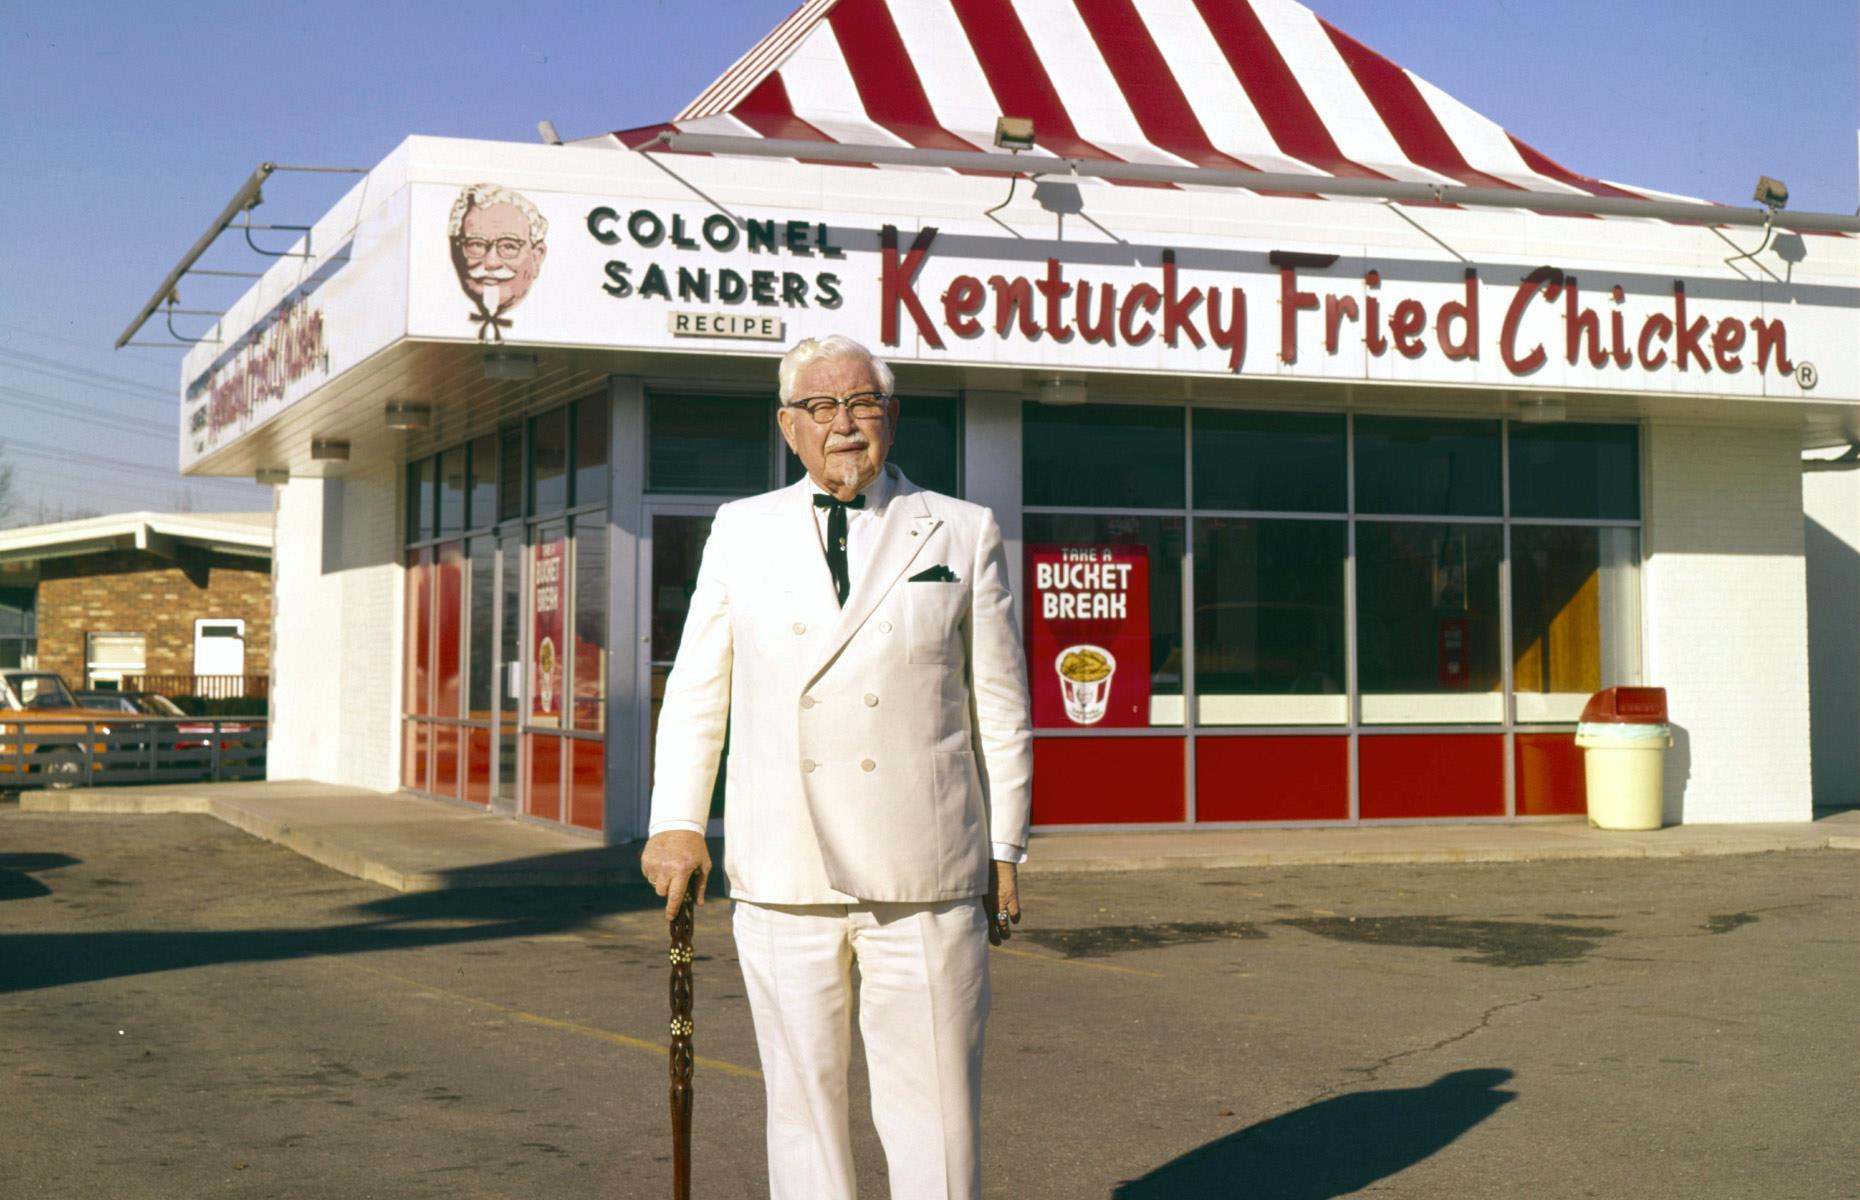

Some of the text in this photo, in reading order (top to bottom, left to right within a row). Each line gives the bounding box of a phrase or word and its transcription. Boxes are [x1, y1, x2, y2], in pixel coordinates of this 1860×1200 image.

[586, 206, 843, 254] COLONEL
[602, 260, 841, 305] SANDERS
[881, 224, 1794, 376] Kentucky Fried Chicken
[676, 314, 773, 335] RECIPE
[1062, 548, 1112, 562] TAKE A
[1037, 563, 1132, 589] BUCKET
[1043, 592, 1126, 619] BREAK
